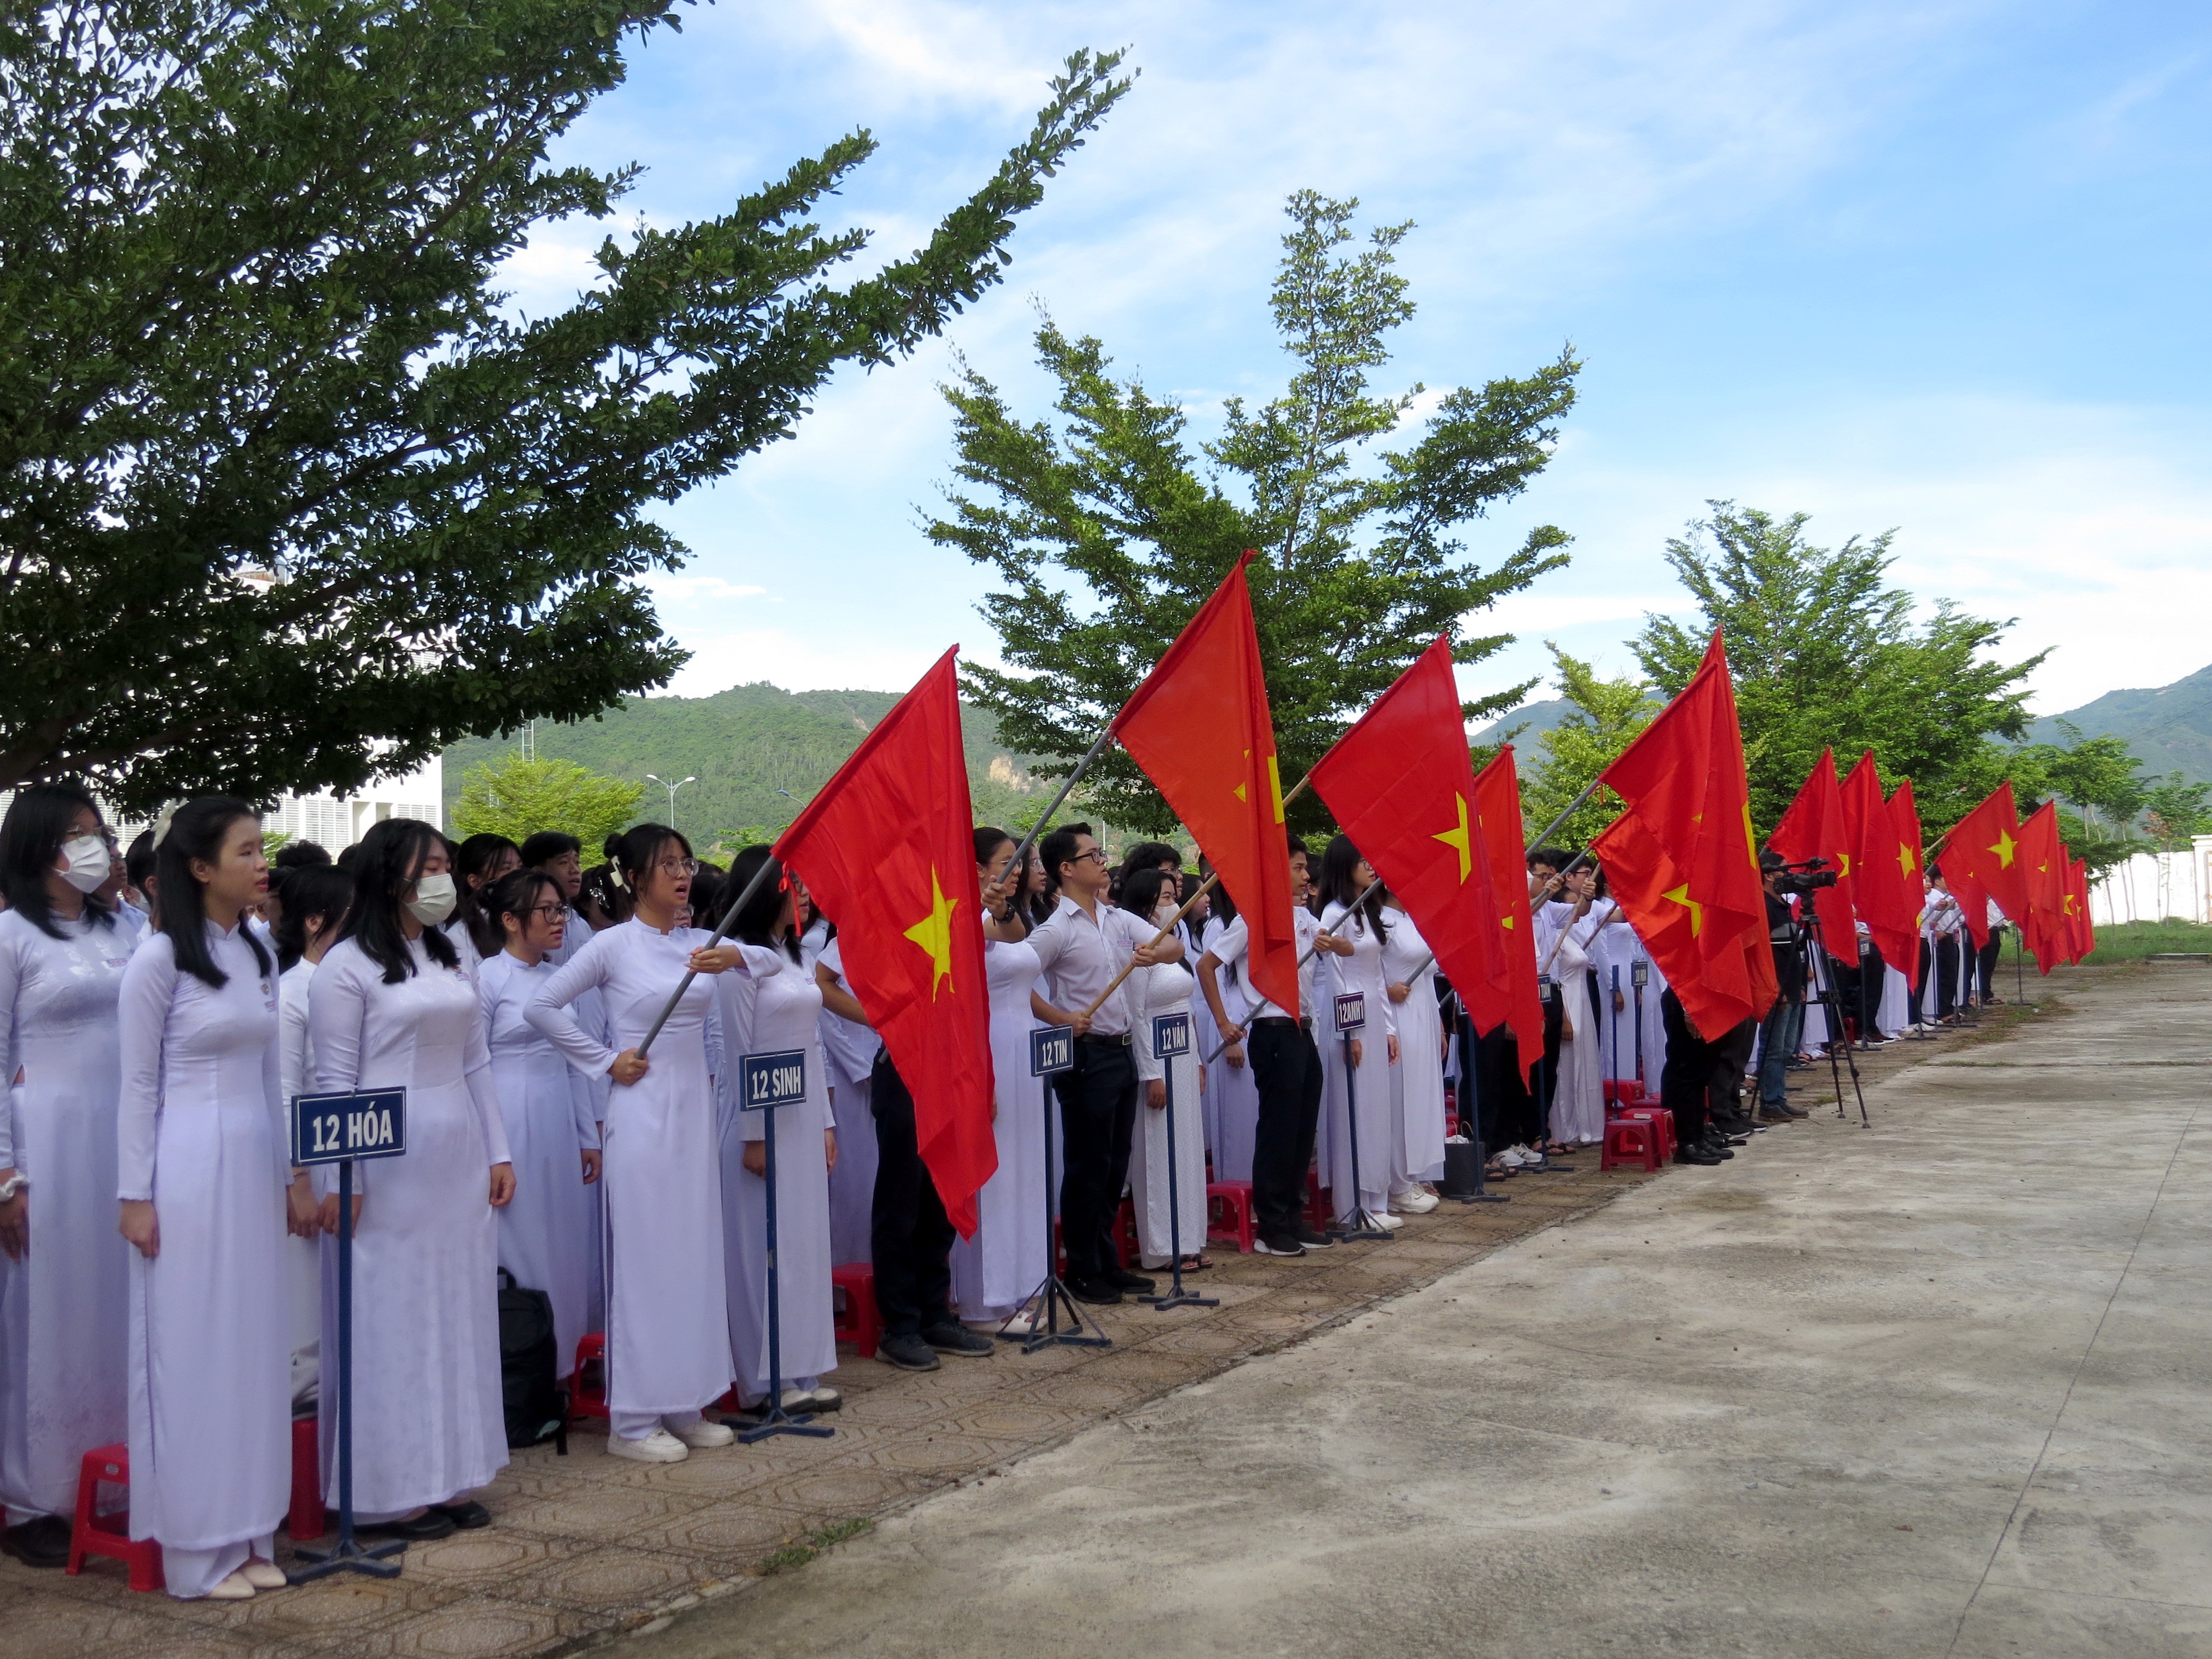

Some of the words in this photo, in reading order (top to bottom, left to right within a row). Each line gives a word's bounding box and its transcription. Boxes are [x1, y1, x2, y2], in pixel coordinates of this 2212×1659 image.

[1338, 1000, 1364, 1024] 12ANH1
[1162, 1027, 1172, 1051] 12
[1172, 1021, 1186, 1048] VĂN
[1042, 1041, 1053, 1067] 12
[1053, 1039, 1067, 1064] TIN
[752, 1070, 769, 1100] 12
[772, 1066, 801, 1097] SINH
[313, 1114, 340, 1152] 12
[348, 1100, 394, 1148] HÓA
